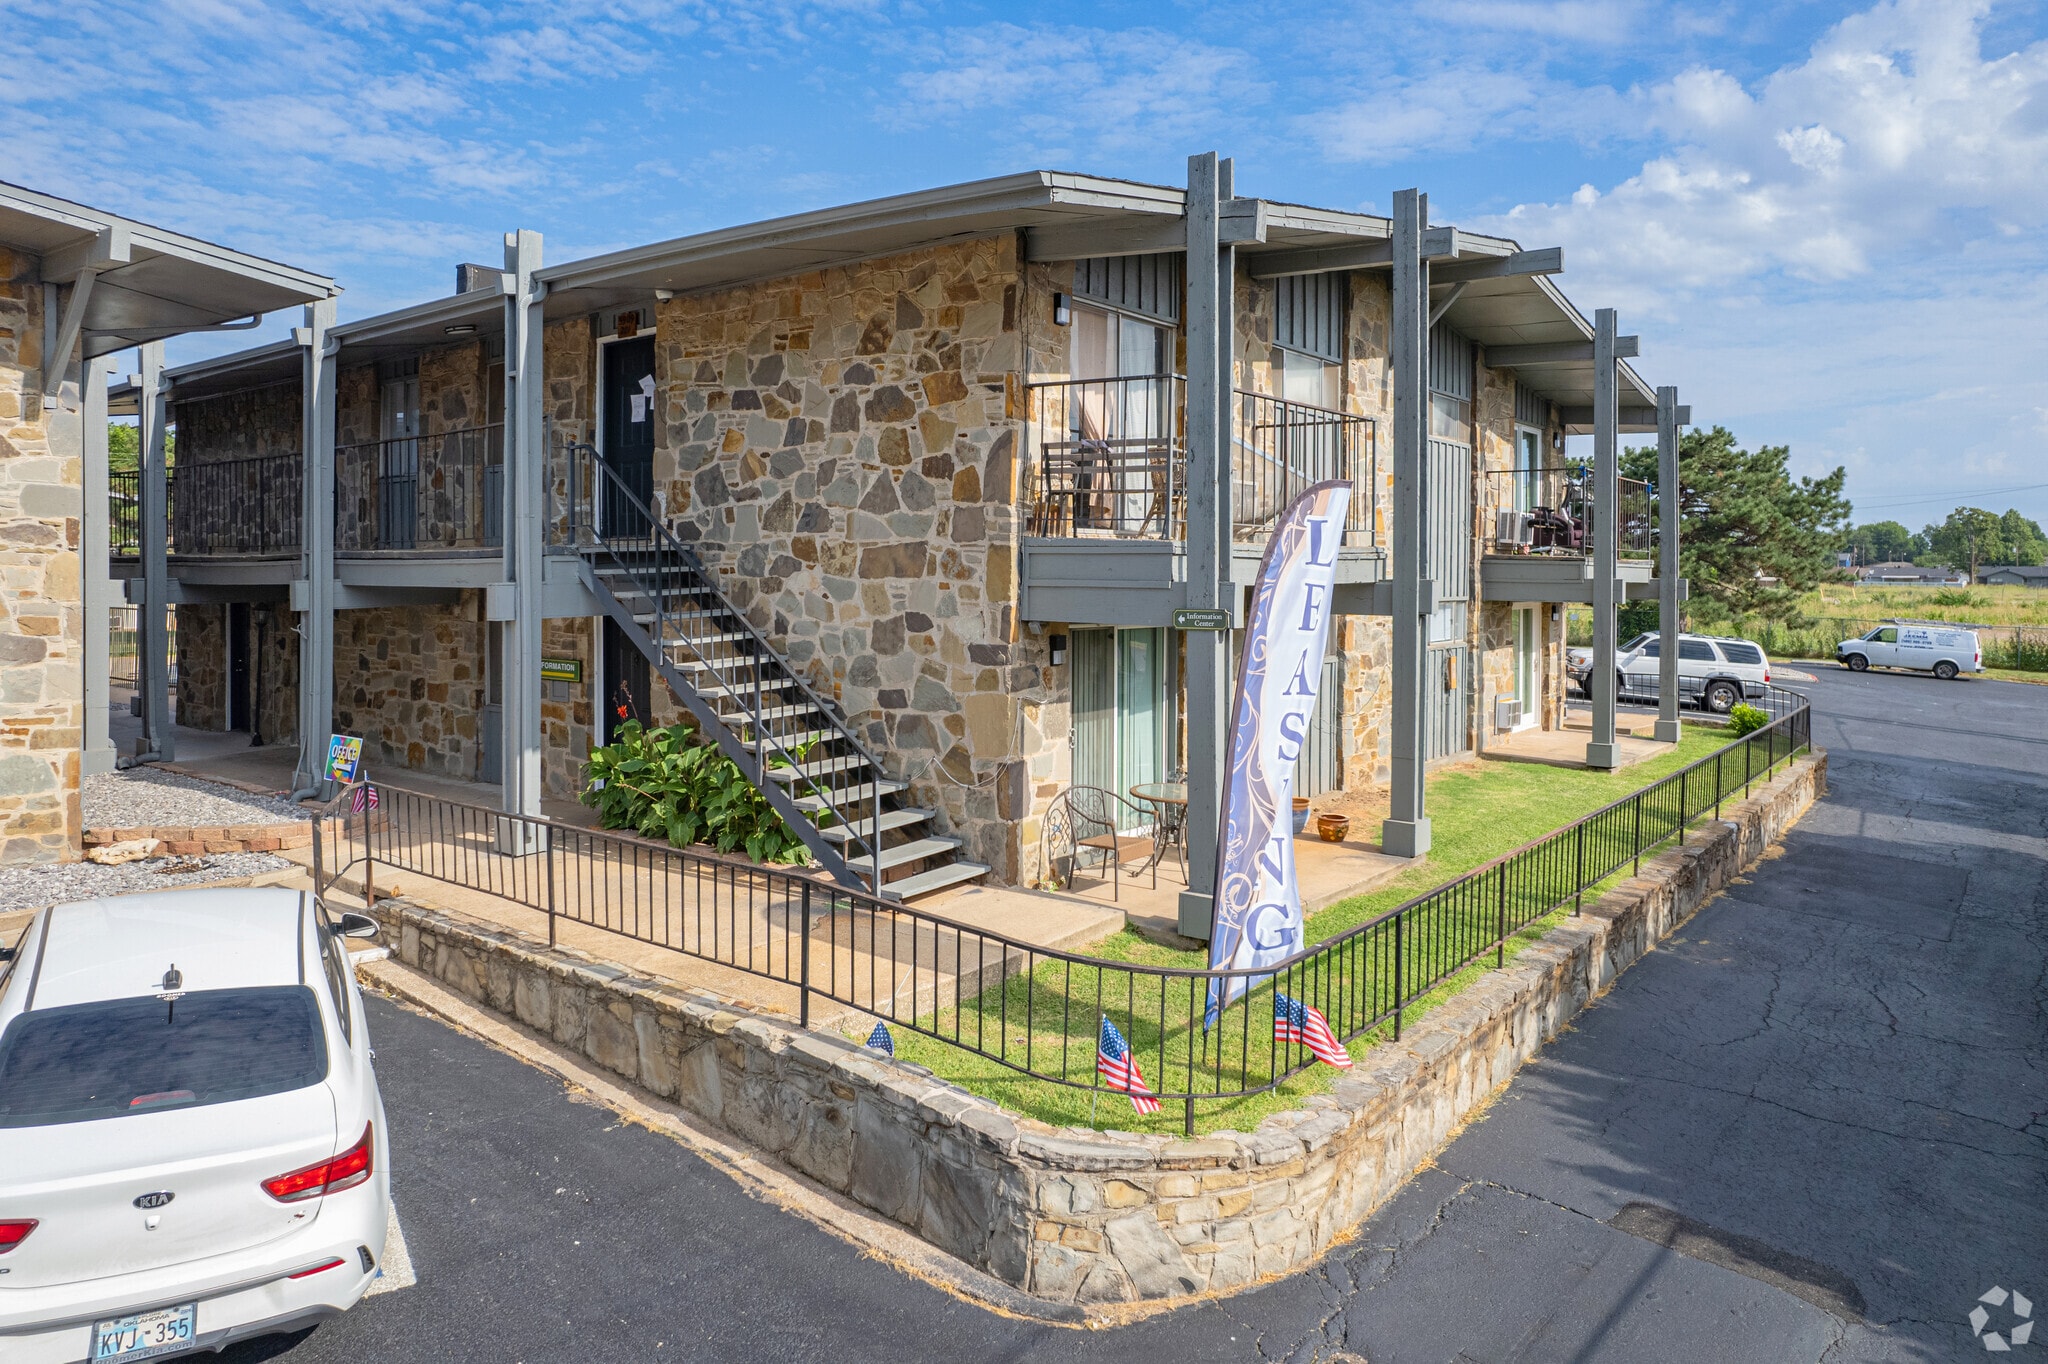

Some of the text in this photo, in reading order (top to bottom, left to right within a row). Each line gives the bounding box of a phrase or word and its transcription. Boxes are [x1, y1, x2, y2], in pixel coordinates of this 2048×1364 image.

[1186, 612, 1223, 620] Information
[541, 661, 575, 672] FORMATION
[1246, 518, 1333, 951] LEASNG
[331, 744, 357, 761] OFFICE
[139, 1194, 169, 1208] KIA
[123, 1313, 170, 1328] OKLAHOMA
[100, 1317, 189, 1356] KVJ 355
